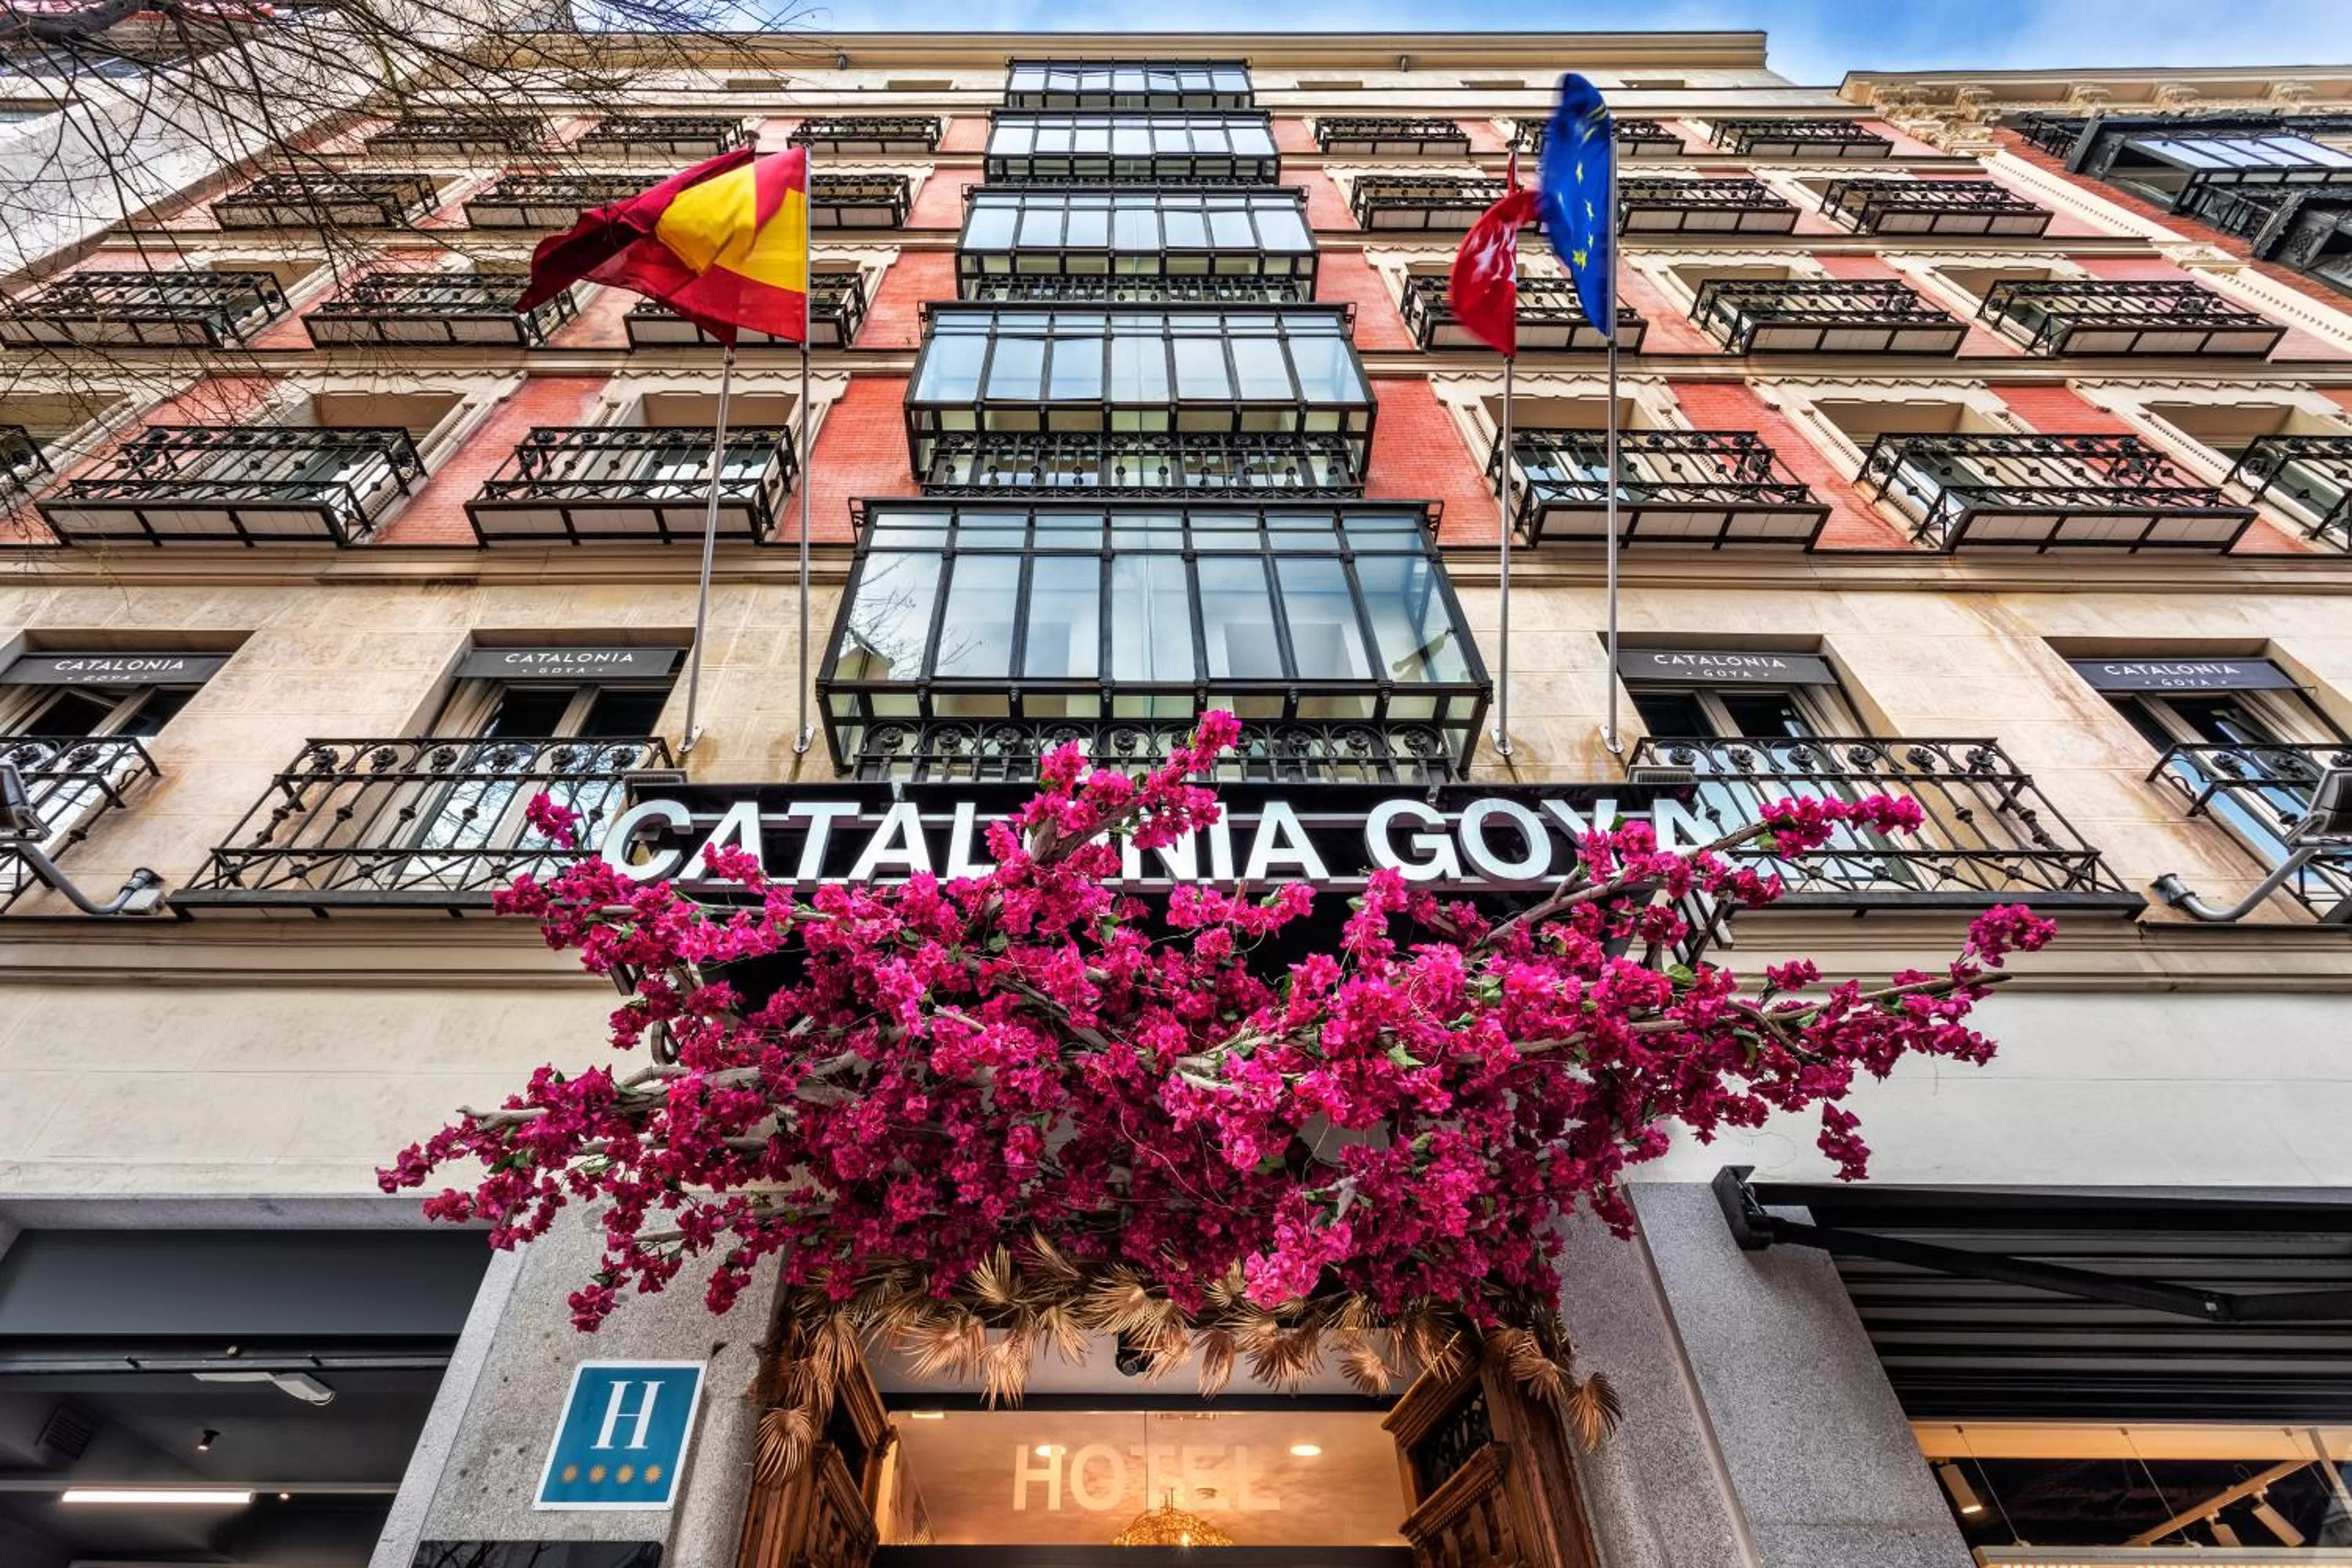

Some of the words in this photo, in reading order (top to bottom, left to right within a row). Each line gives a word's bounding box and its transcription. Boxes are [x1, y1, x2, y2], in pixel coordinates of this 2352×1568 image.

[504, 652, 634, 663] CATALONIA
[1653, 654, 1788, 669] CATALONIA
[54, 659, 184, 671] CATALONIA
[2103, 664, 2241, 675] CATALONIA
[1703, 669, 1753, 678] GOYA
[601, 798, 1330, 883] CATALNIA
[590, 1381, 666, 1450] H
[1012, 1443, 1281, 1512] HOTEL
